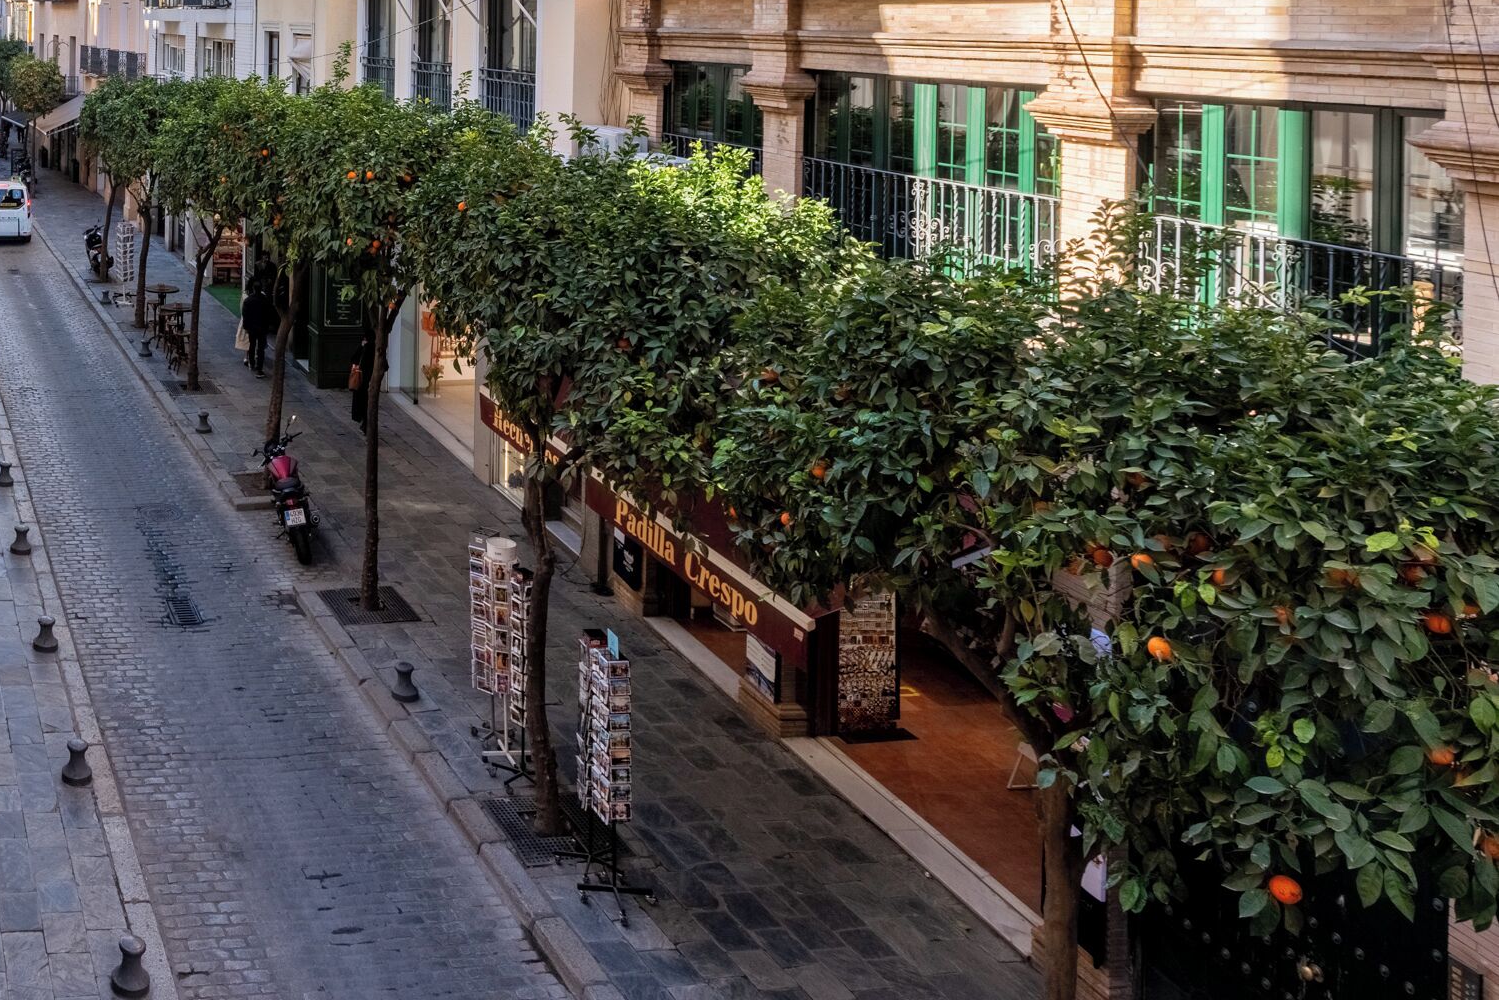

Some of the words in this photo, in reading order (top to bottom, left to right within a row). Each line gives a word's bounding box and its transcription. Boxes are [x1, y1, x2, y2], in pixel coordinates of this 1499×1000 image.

[492, 405, 560, 466] Recueos
[613, 499, 676, 566] Padilla
[684, 550, 758, 626] Crespo
